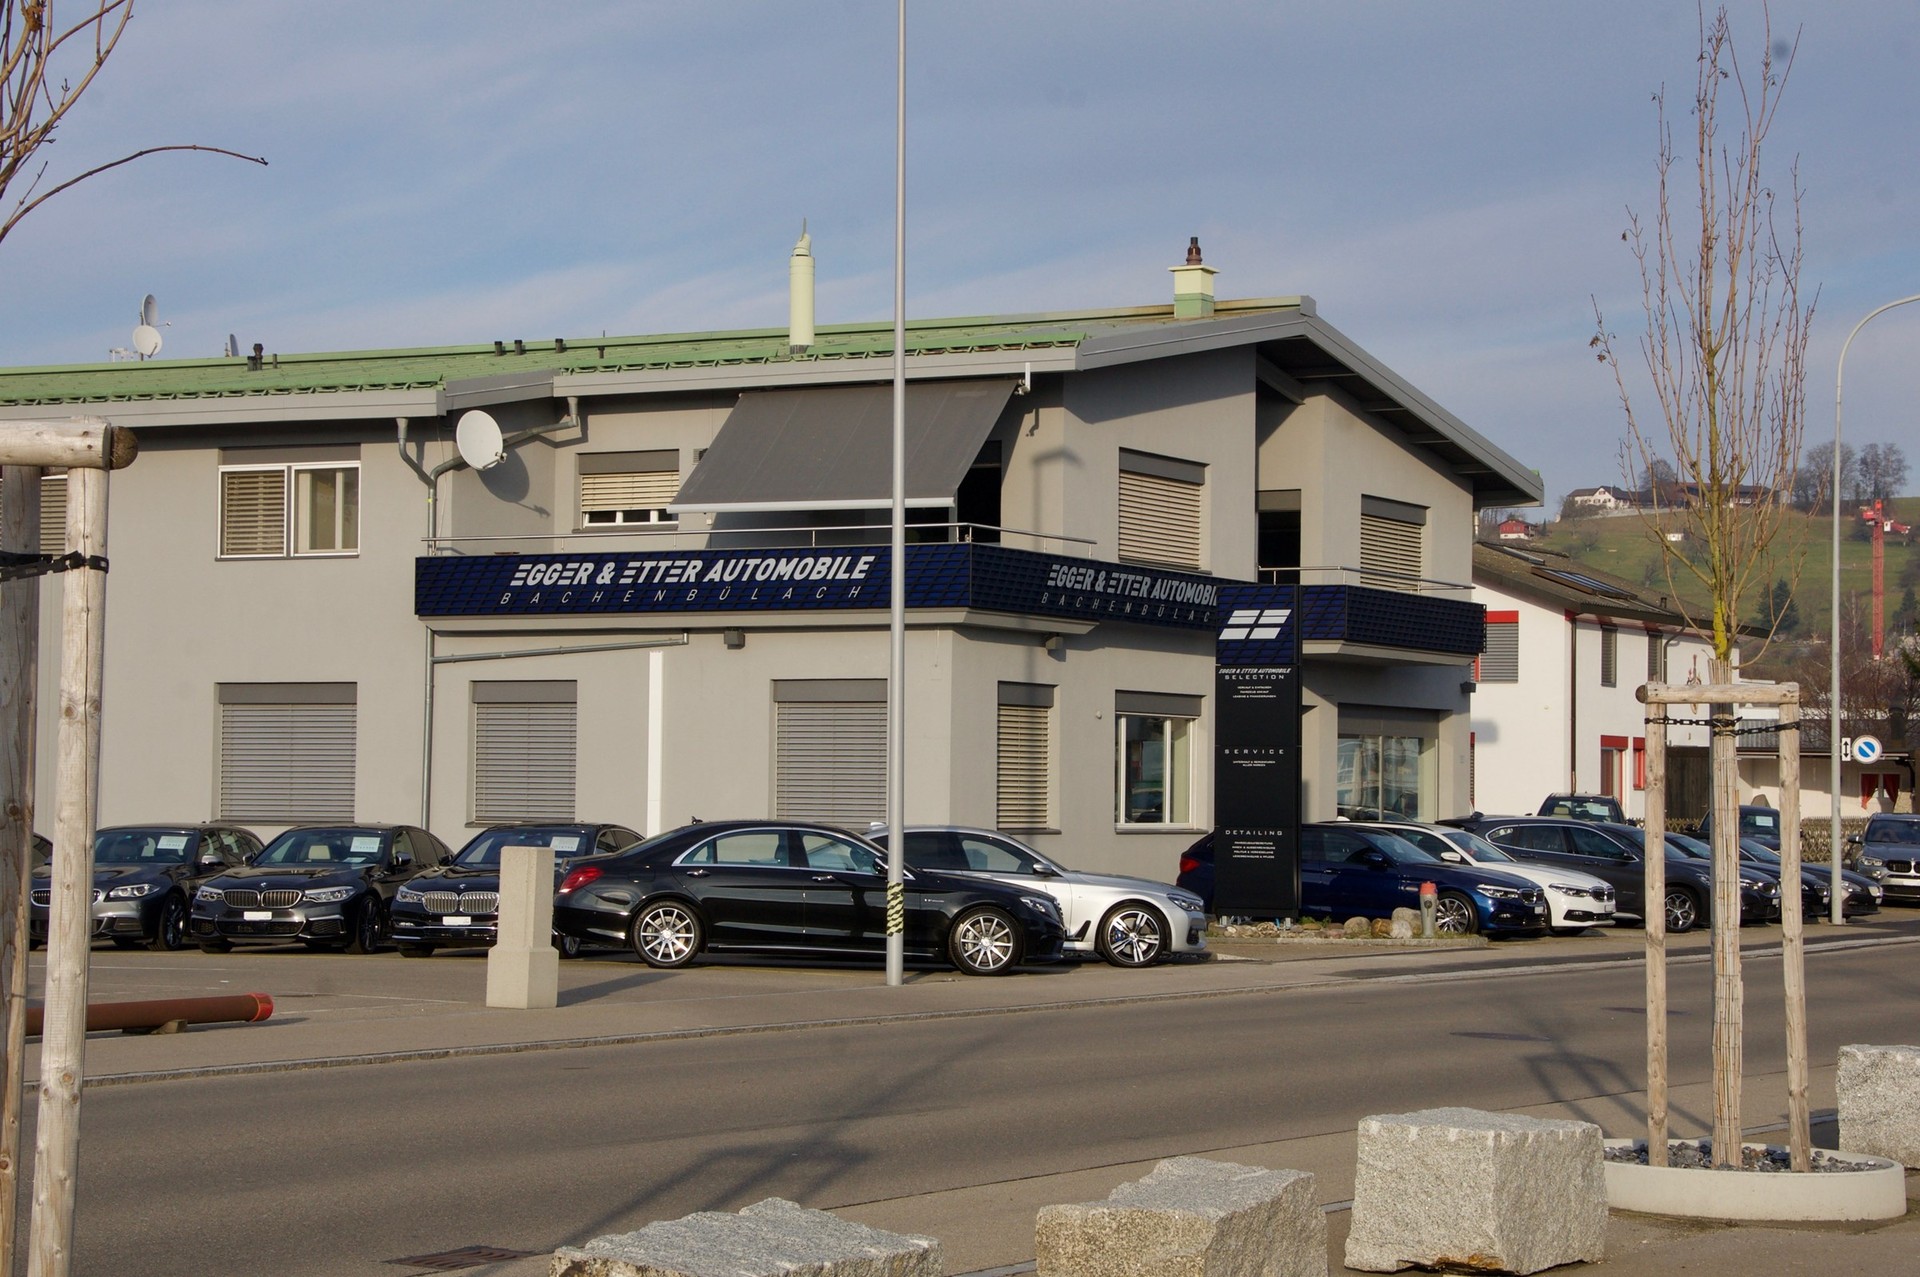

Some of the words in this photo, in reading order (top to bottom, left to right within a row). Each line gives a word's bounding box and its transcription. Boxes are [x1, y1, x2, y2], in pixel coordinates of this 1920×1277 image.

[510, 563, 595, 587] EGGER
[596, 562, 616, 585] &
[619, 559, 704, 584] ETTER
[703, 555, 876, 582] AUTOMOBILE
[1047, 564, 1095, 591] EGGER
[1094, 570, 1107, 593] &
[1106, 572, 1151, 598] ETTER
[500, 585, 863, 605] BACHENBÜLACH
[1041, 592, 1211, 623] BACHENBÜLAC
